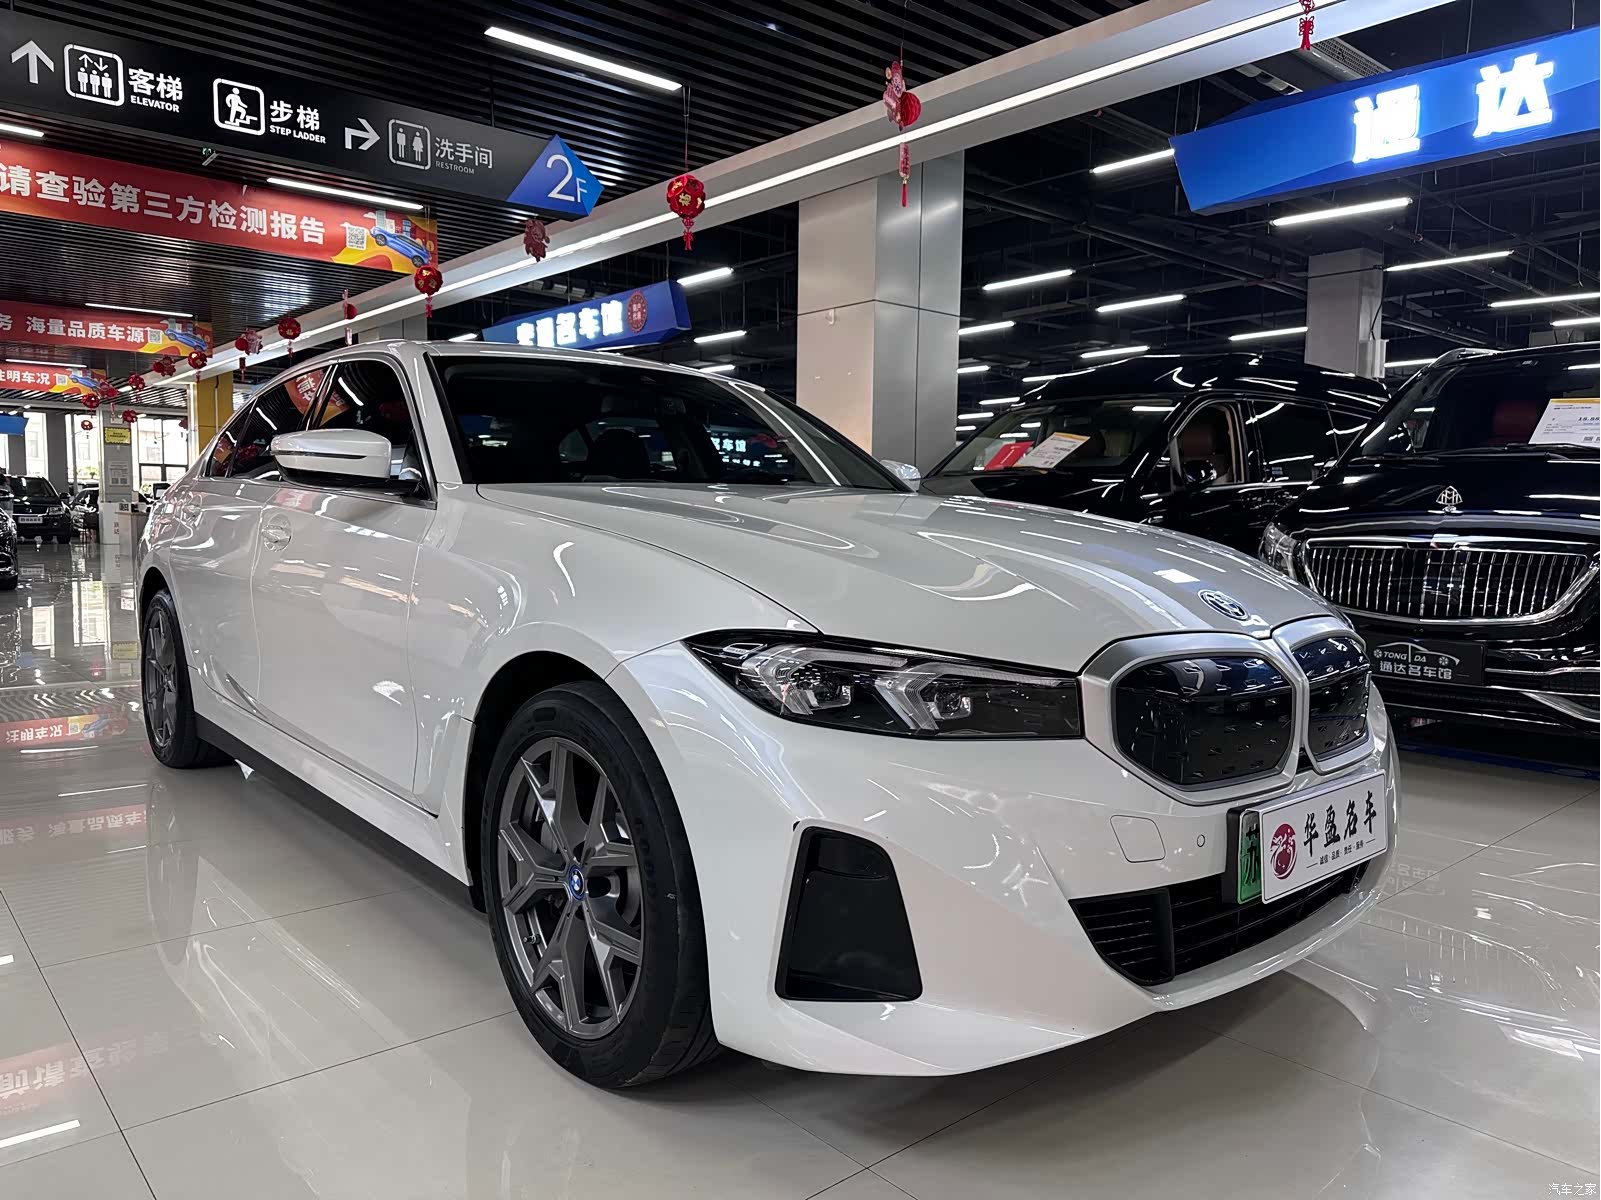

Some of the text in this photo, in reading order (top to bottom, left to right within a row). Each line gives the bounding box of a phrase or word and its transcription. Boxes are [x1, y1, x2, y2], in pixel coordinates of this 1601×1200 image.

[128, 68, 183, 101] 客梯
[130, 95, 180, 113] ELEVATOR
[269, 100, 320, 131] 步梯
[1352, 52, 1553, 164] 通达
[269, 125, 326, 144] STEP LADDER
[434, 136, 493, 169] 洗手间
[435, 160, 475, 175] RESTROOM
[546, 154, 588, 203] 2F
[0, 162, 325, 245] 请查验第三方检测报告
[26, 316, 145, 343] 海量品质车源
[1379, 661, 1452, 680] 通达名车馆
[1383, 651, 1427, 663] TONG DA
[1303, 790, 1377, 857] 华盈名车
